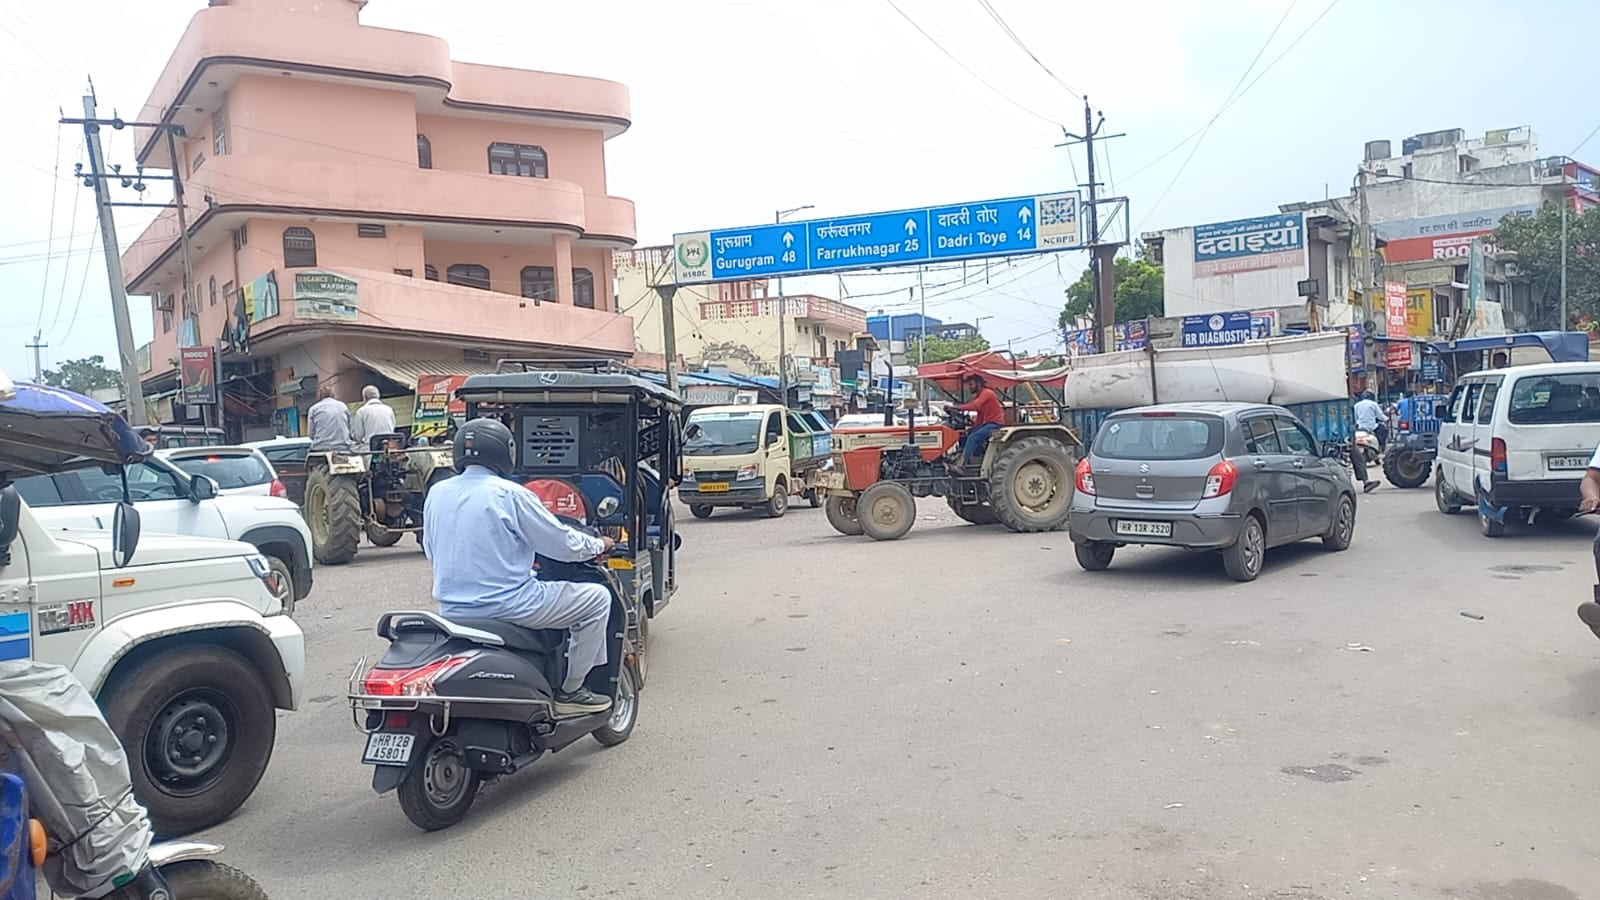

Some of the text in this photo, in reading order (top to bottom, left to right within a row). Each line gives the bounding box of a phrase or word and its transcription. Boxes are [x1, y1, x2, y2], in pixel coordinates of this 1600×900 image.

[937, 205, 998, 227] दादरी तोए
[937, 228, 1032, 250] Dadri Toye 14
[1196, 220, 1301, 255] दवाइयां
[716, 250, 796, 272] Gurugram 48
[817, 239, 920, 261] Farrukhnagar 25
[1185, 329, 1250, 345] RR DIAGNOSTIC
[1121, 522, 1131, 531] HR
[1151, 523, 1170, 534] 2520
[379, 733, 410, 748] HR12B
[373, 748, 405, 761] A5801
